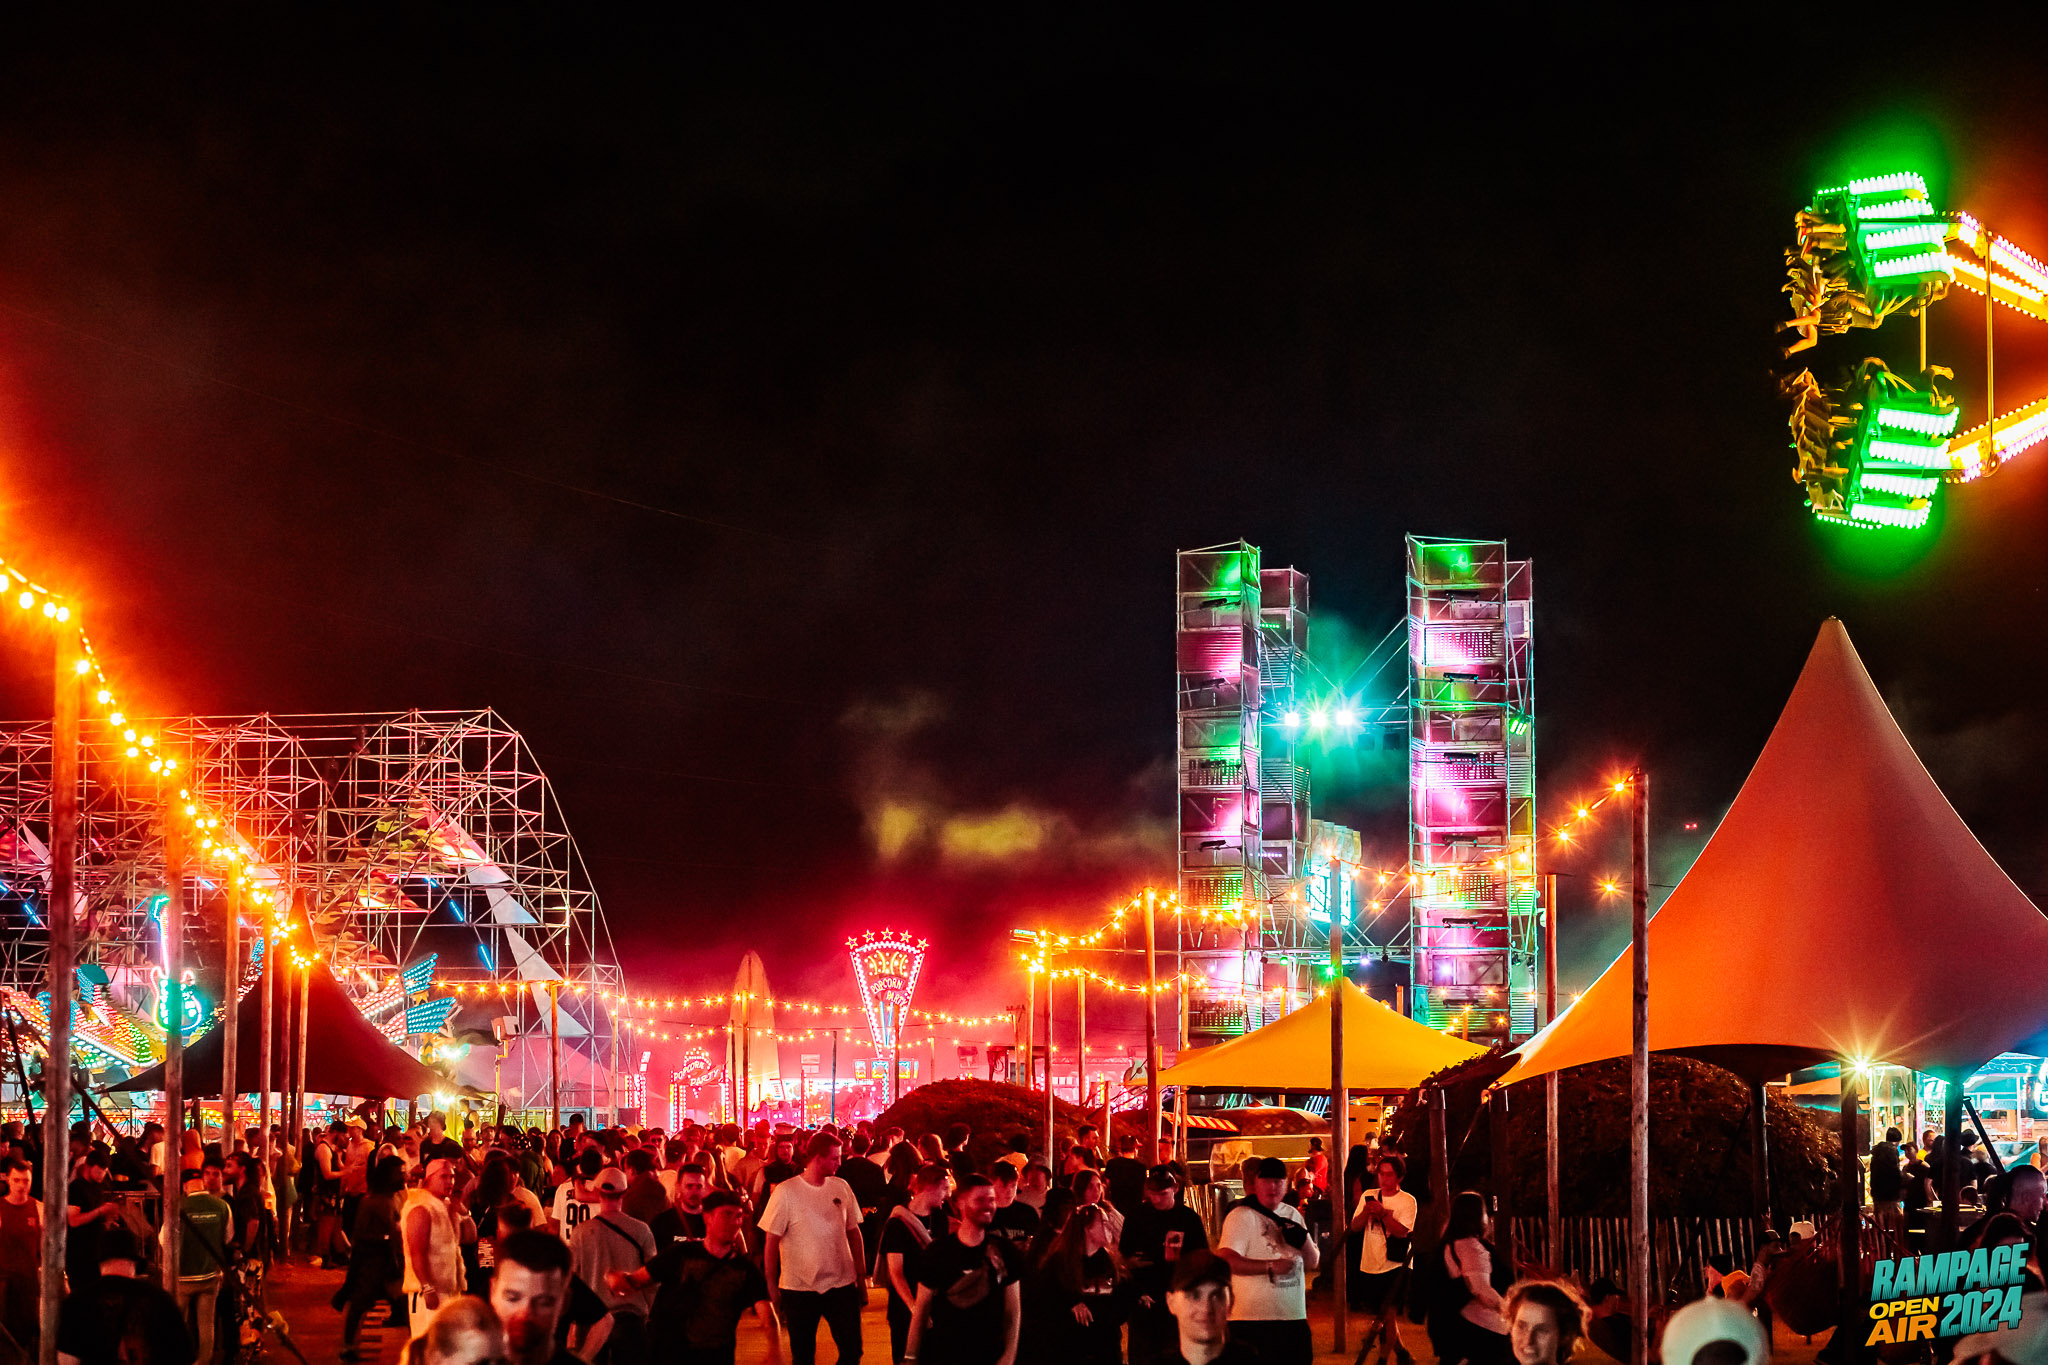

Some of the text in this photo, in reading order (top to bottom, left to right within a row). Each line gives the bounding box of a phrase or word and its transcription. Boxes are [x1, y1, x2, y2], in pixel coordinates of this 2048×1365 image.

[871, 976, 903, 993] POPCORN
[886, 990, 907, 1006] PARTY
[673, 1060, 705, 1082] POPCORN
[690, 1069, 720, 1087] PARTY
